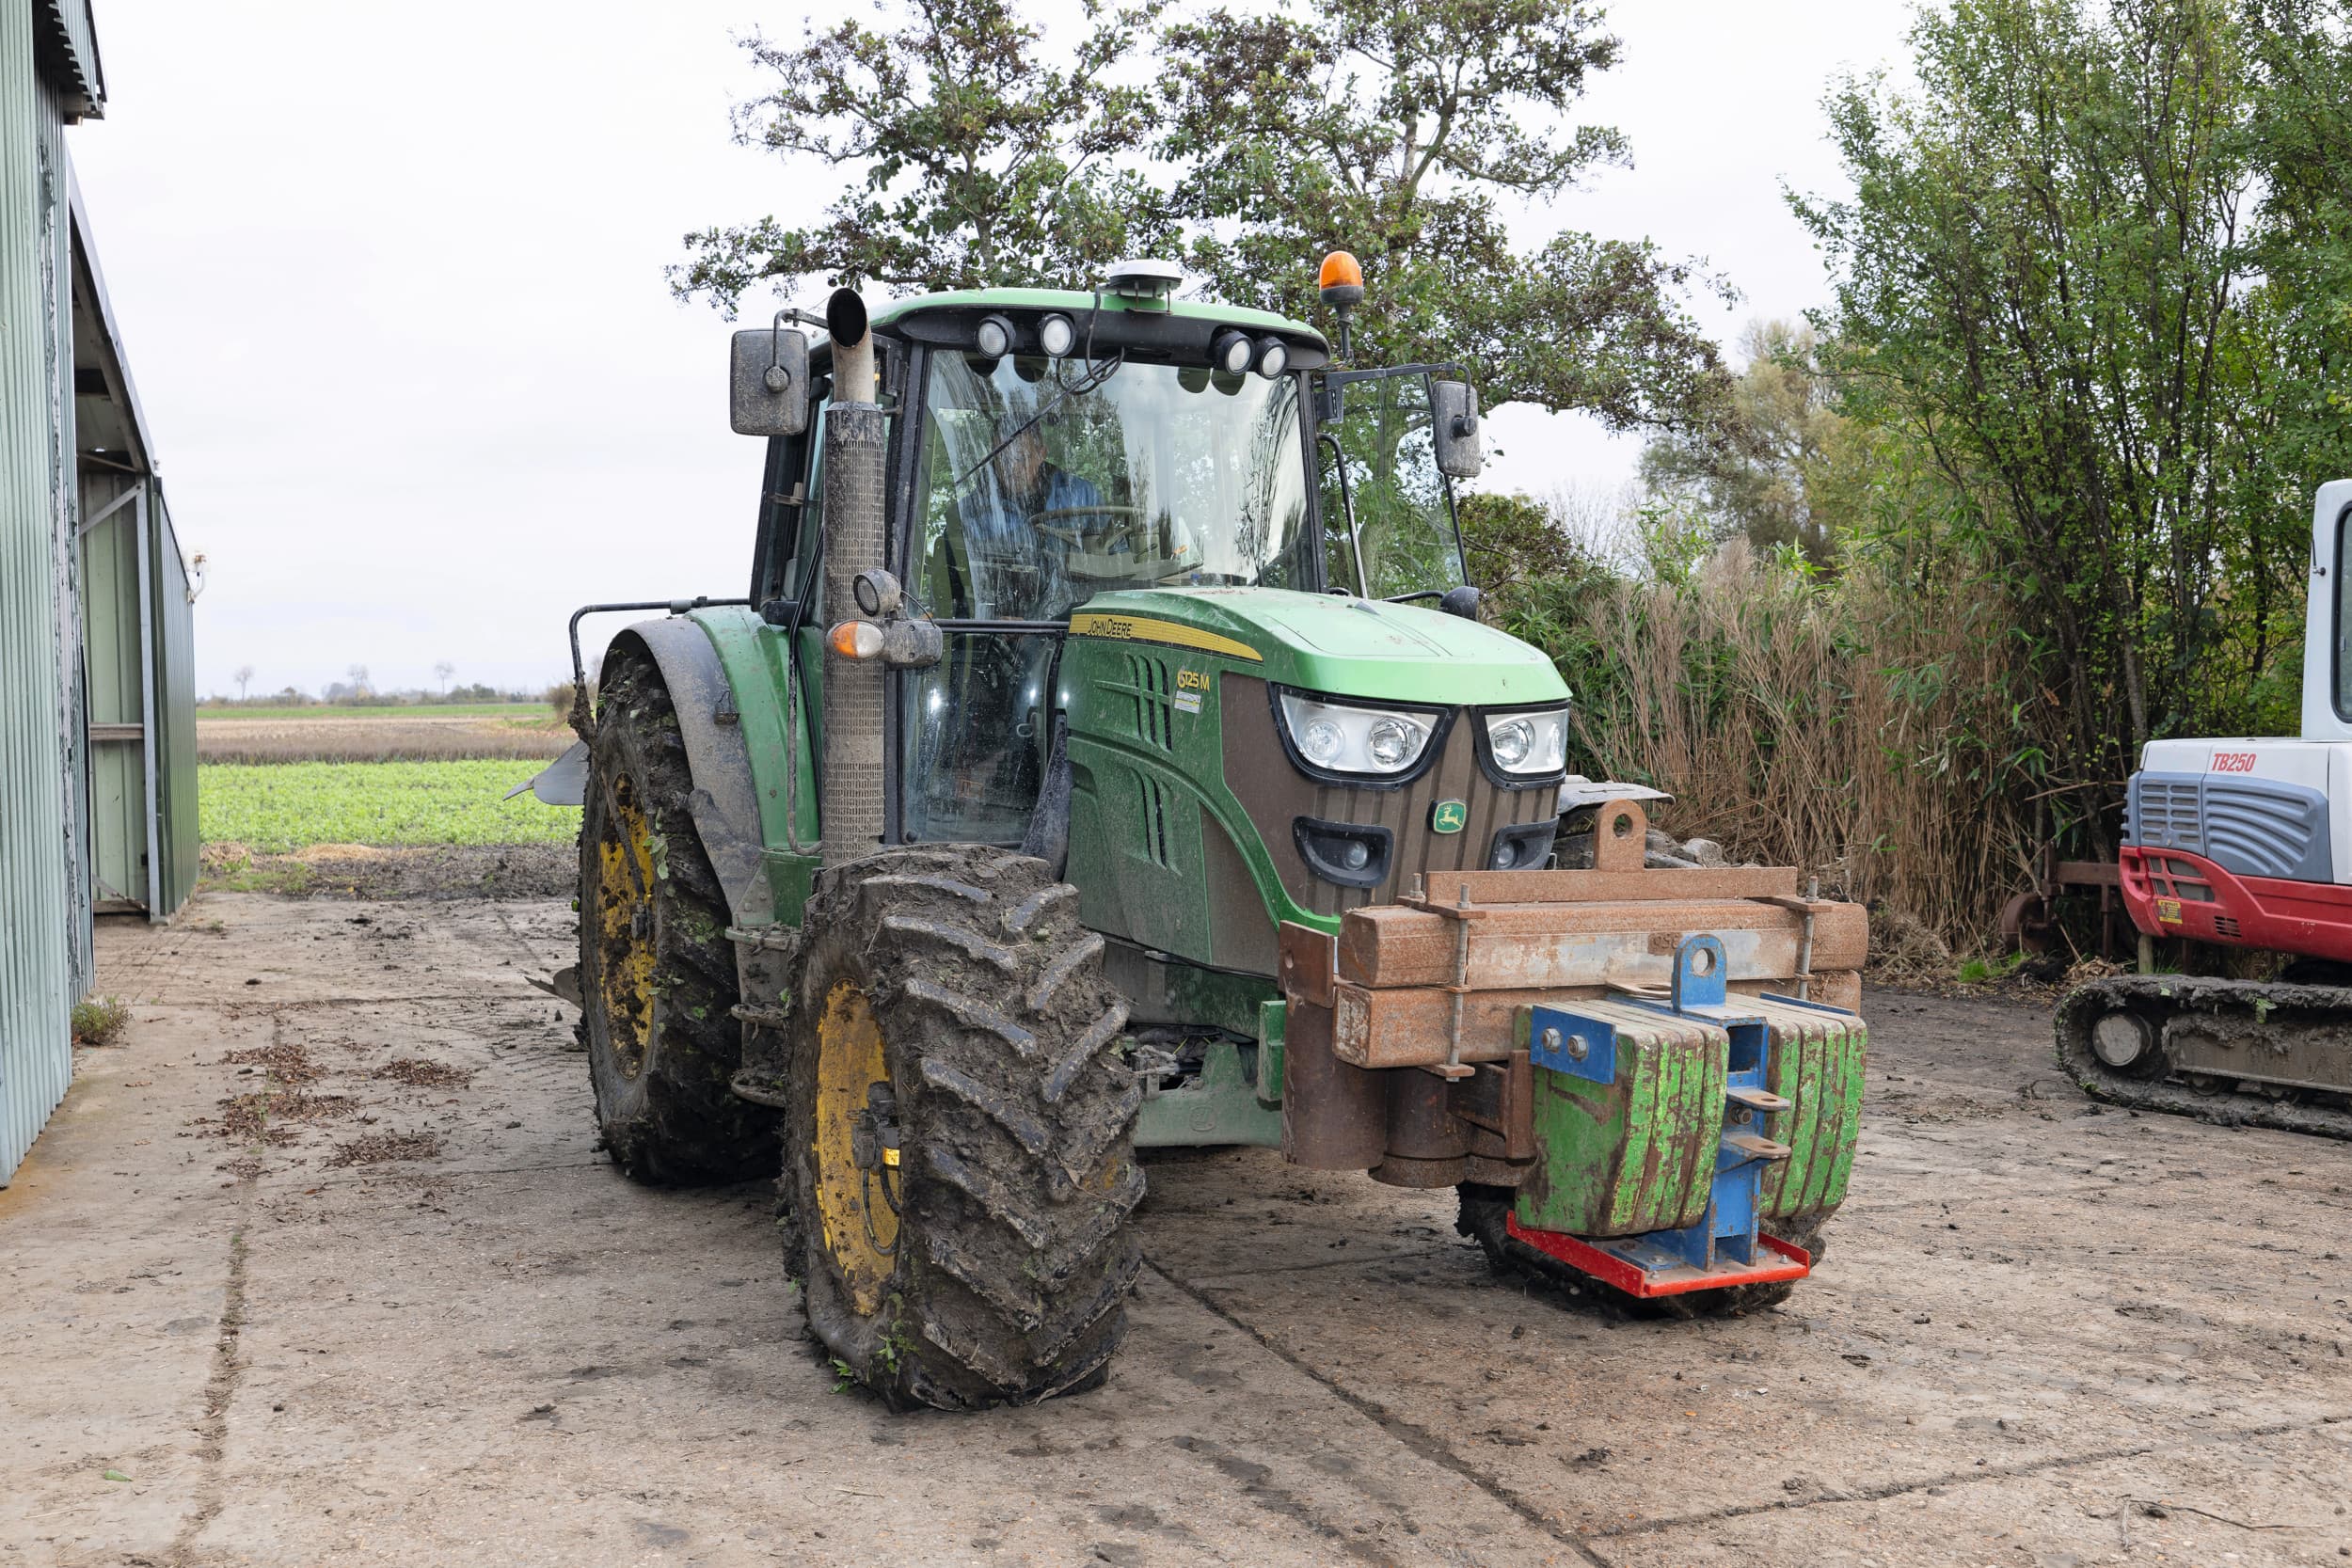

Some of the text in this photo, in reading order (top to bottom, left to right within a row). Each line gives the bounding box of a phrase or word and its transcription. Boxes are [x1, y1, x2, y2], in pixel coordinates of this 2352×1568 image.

[1177, 671, 1210, 692] 6125 M
[2212, 752, 2257, 772] TB250
